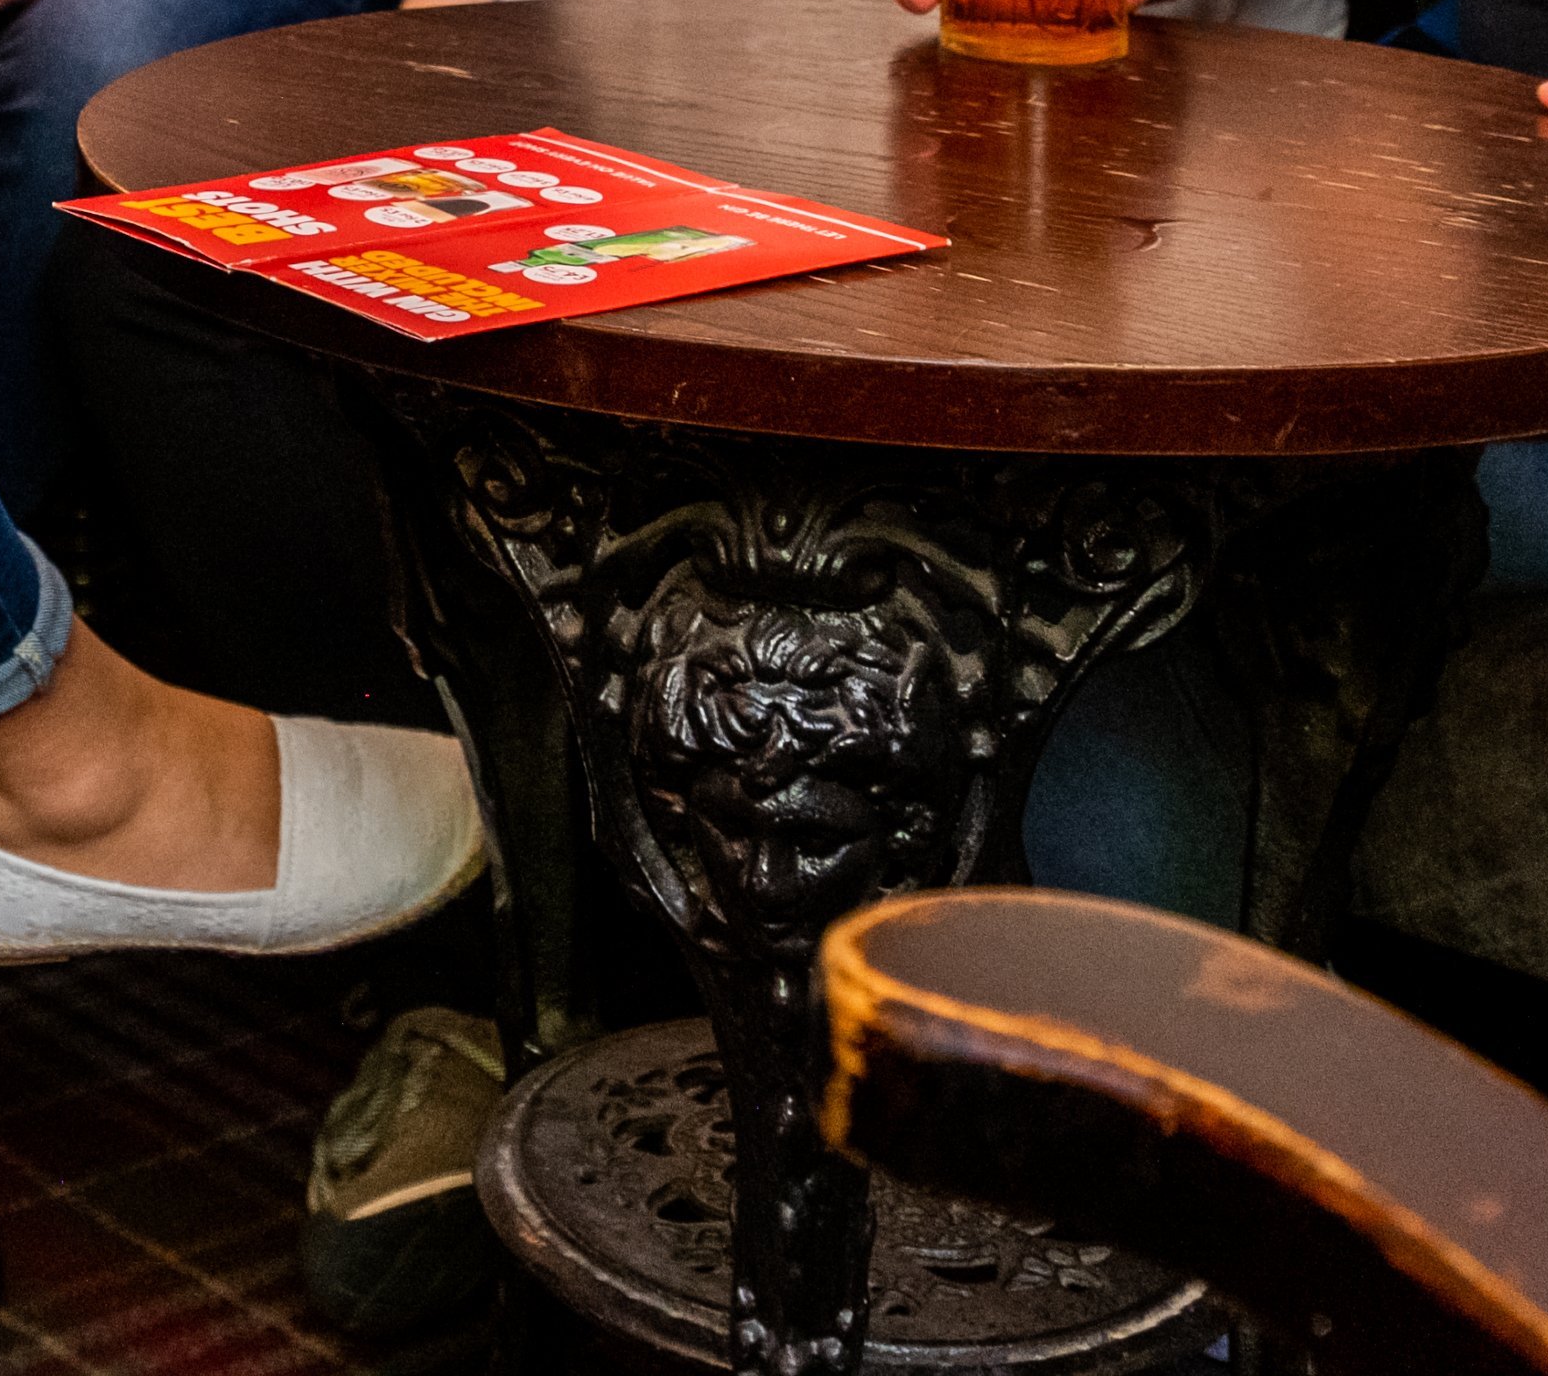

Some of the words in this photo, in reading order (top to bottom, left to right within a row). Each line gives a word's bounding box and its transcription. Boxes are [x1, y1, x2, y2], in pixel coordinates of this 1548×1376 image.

[118, 195, 294, 246] BEST
[180, 189, 338, 236] SHOTS
[288, 259, 394, 299] WITH
[329, 253, 452, 297] MIXER
[360, 249, 546, 312] INCLUDED
[392, 294, 471, 323] GIN
[428, 291, 506, 318] THE
